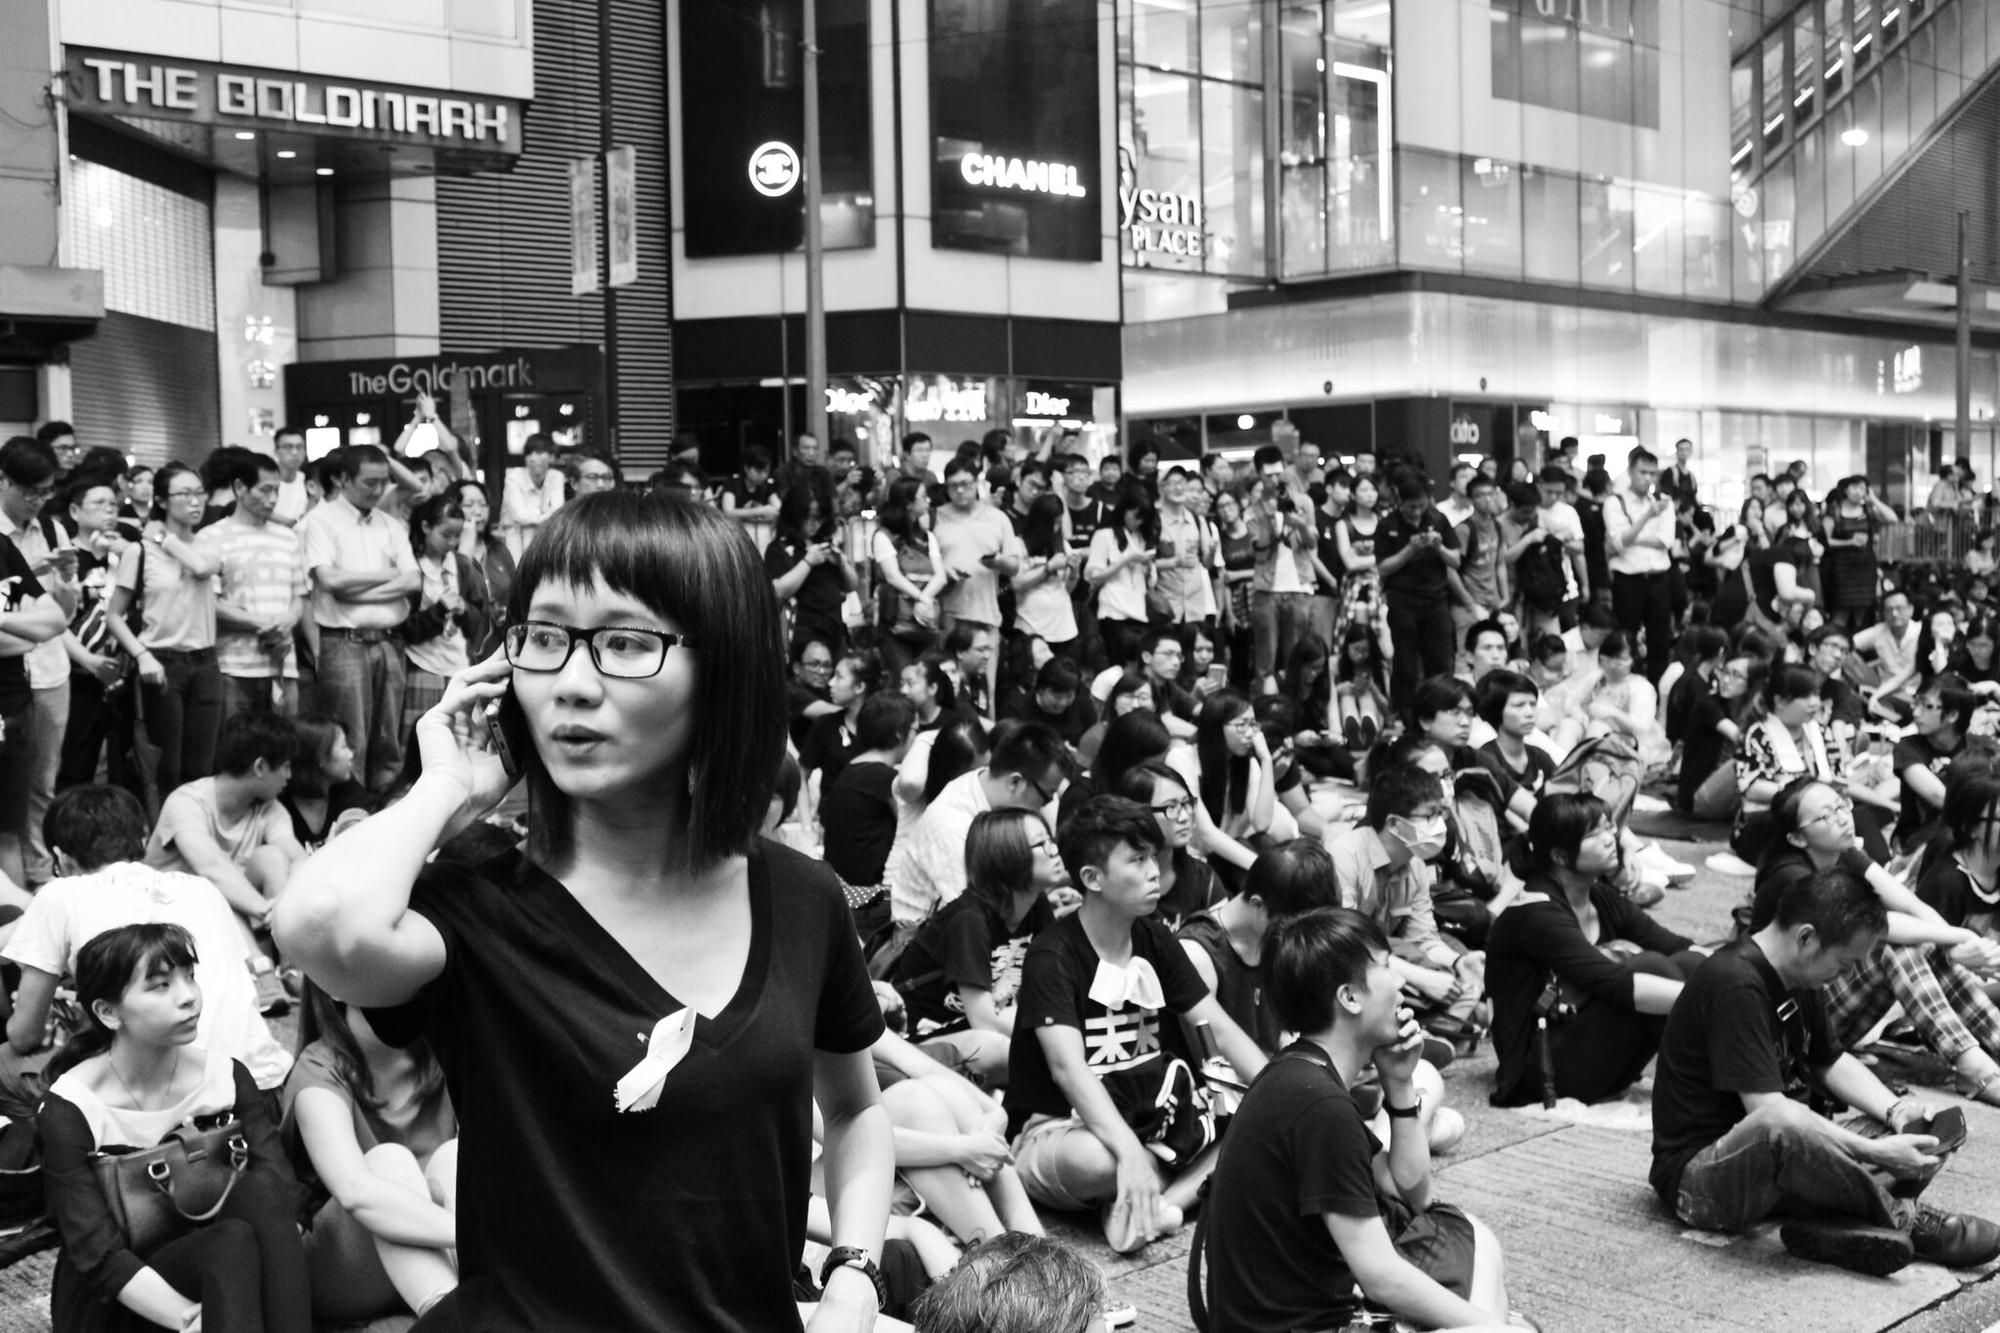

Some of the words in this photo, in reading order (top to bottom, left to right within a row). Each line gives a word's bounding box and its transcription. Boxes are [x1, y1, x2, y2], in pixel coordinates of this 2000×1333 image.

[83, 57, 199, 110] THE
[217, 73, 508, 142] GOLDMARK
[961, 152, 1086, 197] CHANEL
[1119, 186, 1201, 230] ysan
[1131, 224, 1201, 256] PLACE
[1026, 391, 1070, 416] Dior
